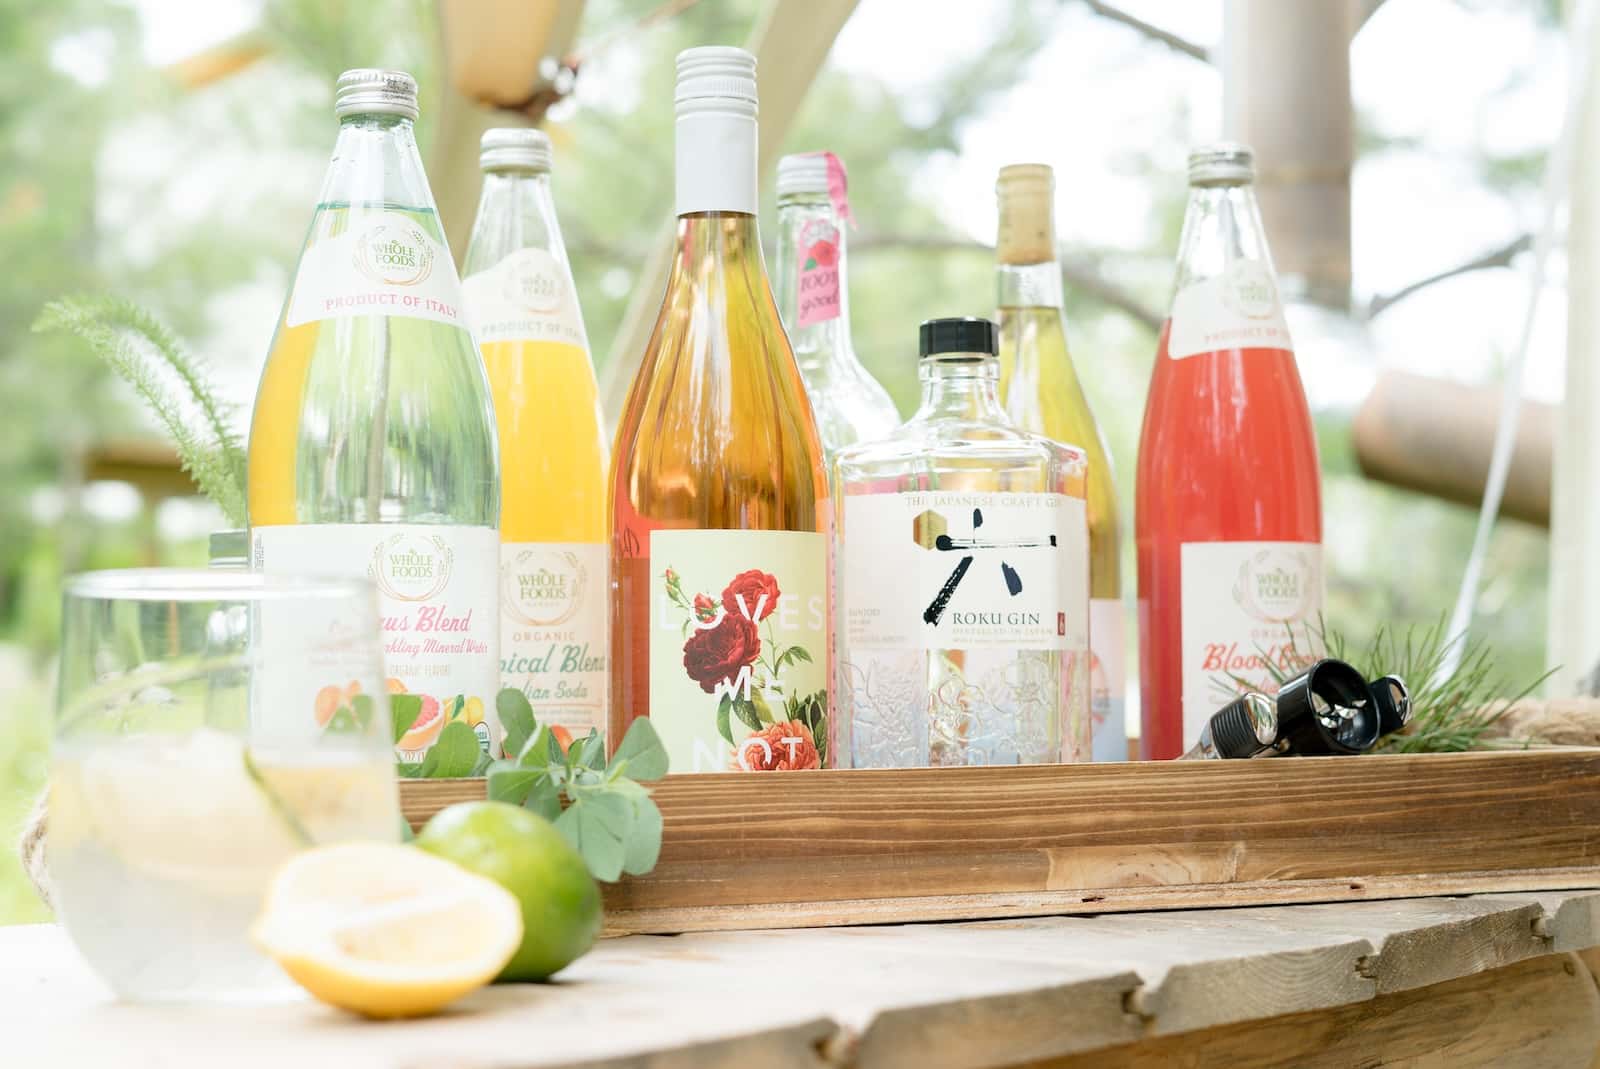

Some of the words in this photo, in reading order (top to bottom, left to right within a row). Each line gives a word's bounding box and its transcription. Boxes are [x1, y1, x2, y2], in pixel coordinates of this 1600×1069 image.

[373, 242, 415, 257] WHOLE
[375, 254, 416, 267] FOODS
[326, 294, 398, 311] PRODUCT
[403, 295, 422, 307] OF
[426, 299, 457, 318] ITALY
[905, 496, 926, 506] THE
[934, 496, 993, 507] JAPANESE
[1002, 496, 1040, 506] CRAFT
[390, 553, 434, 566] WHOLE
[391, 566, 433, 578] FOODS
[518, 574, 568, 586] WHOLE
[520, 586, 567, 600] FOODS
[415, 605, 472, 632] Blend
[658, 593, 824, 630] LOVES
[952, 612, 1001, 625] ROKU
[1007, 612, 1041, 625] GIN
[512, 631, 576, 642] ORGANIC
[423, 637, 466, 654] Mineral
[554, 680, 588, 699] Soda
[714, 666, 786, 701] ME
[692, 736, 803, 771] NOT
